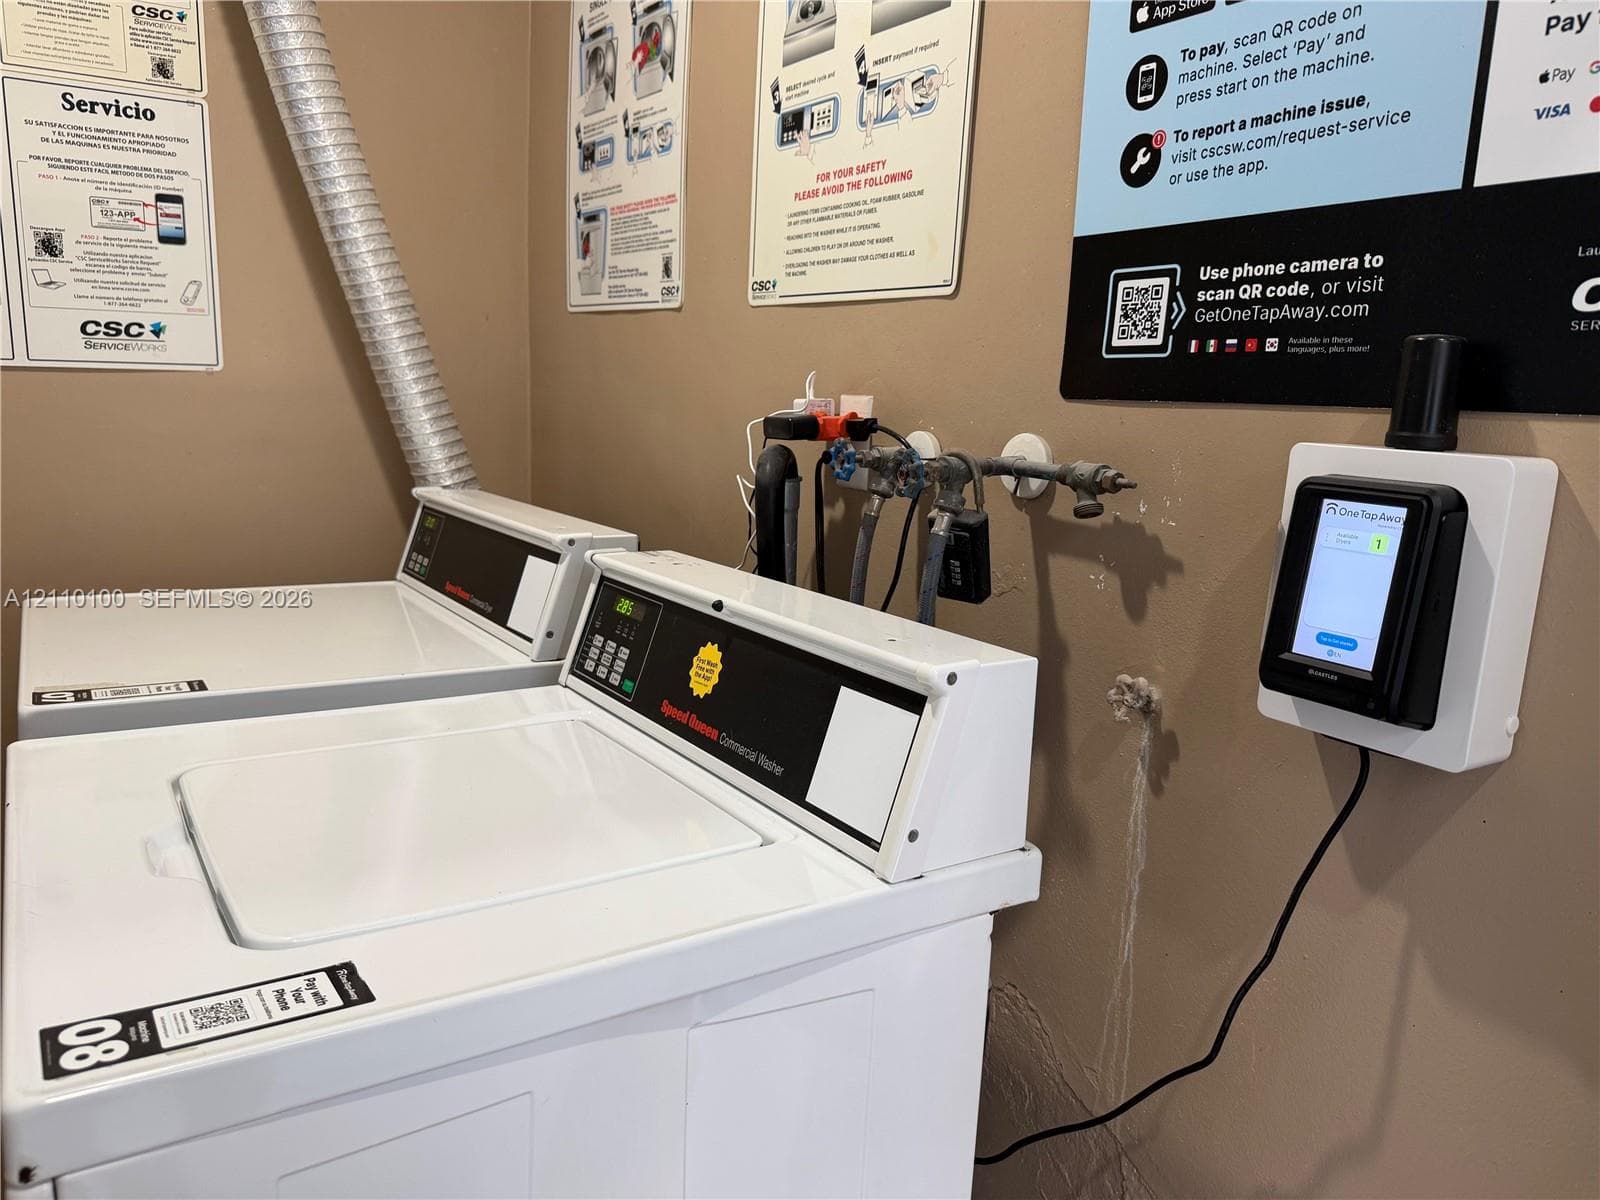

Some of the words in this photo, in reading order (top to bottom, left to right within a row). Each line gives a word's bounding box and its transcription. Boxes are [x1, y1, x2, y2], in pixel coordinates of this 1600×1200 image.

[131, 5, 174, 20] CSC
[1153, 4, 1176, 19] App
[1545, 12, 1592, 36] Pay
[1180, 48, 1196, 62] To
[1200, 39, 1228, 59] pay,
[1233, 30, 1266, 49] scan
[1272, 20, 1293, 40] QR
[1298, 10, 1336, 32] code
[1342, 5, 1362, 20] on
[872, 54, 892, 66] INSERT
[892, 48, 914, 63] payment
[914, 47, 918, 56] if
[918, 40, 940, 55] required
[1178, 60, 1237, 84] machine.
[1243, 46, 1288, 69] Select
[1334, 25, 1366, 46] and
[1176, 88, 1212, 108] press
[1216, 77, 1247, 96] start
[1252, 74, 1270, 88] on
[1274, 65, 1297, 82] the
[1302, 50, 1374, 78] machine.
[1552, 68, 1576, 83] Pay
[786, 82, 802, 92] SELECT
[62, 92, 156, 121] Servicio
[1534, 103, 1571, 120] VISA
[1173, 130, 1188, 143] To
[1192, 120, 1235, 141] report
[1238, 118, 1246, 131] a
[1250, 104, 1316, 128] machine
[1320, 93, 1370, 115] issue,
[35, 120, 83, 131] SATISFACCION
[94, 127, 136, 138] IMPORTANTE
[155, 135, 189, 144] NOSOTROS
[67, 132, 126, 144] FUNCIONAMIENTO
[128, 139, 165, 149] APROPIADO
[1171, 148, 1196, 164] visit
[1200, 109, 1411, 160] cscsw.com/request-service
[65, 140, 101, 149] MAQUINAS
[112, 145, 141, 153] NUESTRA
[142, 148, 176, 157] PRIORIDAD
[48, 163, 79, 172] SIGUIENDO
[64, 158, 89, 166] REPORTE
[91, 161, 122, 169] CUALQUIER
[123, 164, 152, 172] PROBLEMA
[165, 168, 190, 176] SERVICIO,
[816, 171, 831, 184] FOR
[832, 167, 853, 181] YOUR
[856, 160, 886, 176] SAFETY
[1169, 172, 1182, 186] or
[1186, 167, 1208, 182] use
[1213, 162, 1234, 178] the
[1238, 158, 1268, 178] app.
[794, 187, 820, 202] PLEASE
[822, 183, 844, 197] AVOID
[846, 180, 862, 192] THE
[864, 170, 912, 189] FOLLOWING
[100, 210, 136, 218] 123-APP
[1200, 265, 1228, 282] Use
[1232, 262, 1286, 282] phone
[1290, 256, 1359, 274] camera
[1363, 252, 1384, 269] to
[660, 286, 676, 296] CSC
[752, 280, 772, 292] CSC
[1197, 288, 1235, 302] scan
[1238, 282, 1262, 300] QR
[1266, 281, 1314, 299] code,
[1321, 280, 1342, 295] or
[1346, 276, 1384, 293] visit
[1194, 302, 1369, 324] GetOneTapAway.com
[80, 320, 145, 338] CSC
[1288, 336, 1320, 344] Available
[1322, 336, 1328, 344] in
[1330, 336, 1354, 344] these
[1287, 345, 1327, 354] languages,
[1329, 346, 1344, 354] plus
[1346, 344, 1370, 352] more!
[1339, 507, 1360, 518] One
[1360, 510, 1378, 522] Tap
[1376, 539, 1382, 550] 1
[696, 656, 706, 664] First
[696, 664, 706, 672] Free
[661, 700, 690, 724] Speed
[690, 714, 719, 742] Queen
[720, 732, 758, 762] Commercial
[758, 752, 784, 776] Washer
[304, 977, 318, 991] Pay
[272, 988, 290, 1012] Phone
[290, 987, 306, 1004] Your
[310, 990, 328, 1006] with
[58, 1018, 130, 1070] 08
